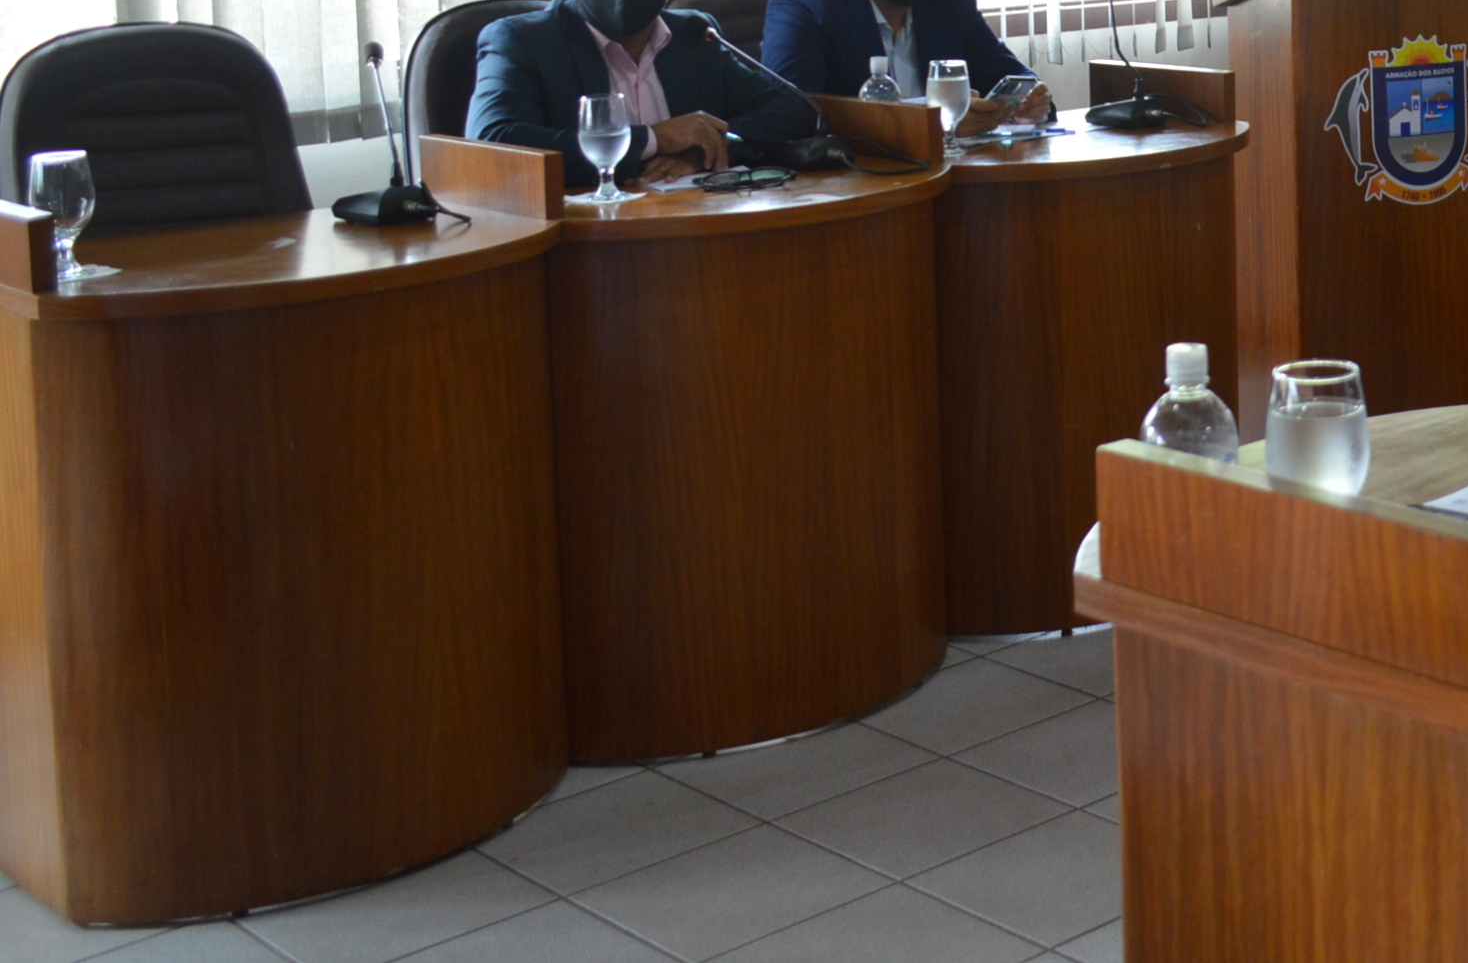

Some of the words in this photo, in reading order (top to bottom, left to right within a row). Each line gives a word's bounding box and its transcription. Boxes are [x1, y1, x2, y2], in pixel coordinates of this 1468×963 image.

[1385, 69, 1417, 79] ARMAÇÃO
[1418, 69, 1432, 77] DOS
[1433, 67, 1455, 76] BÚZIOS
